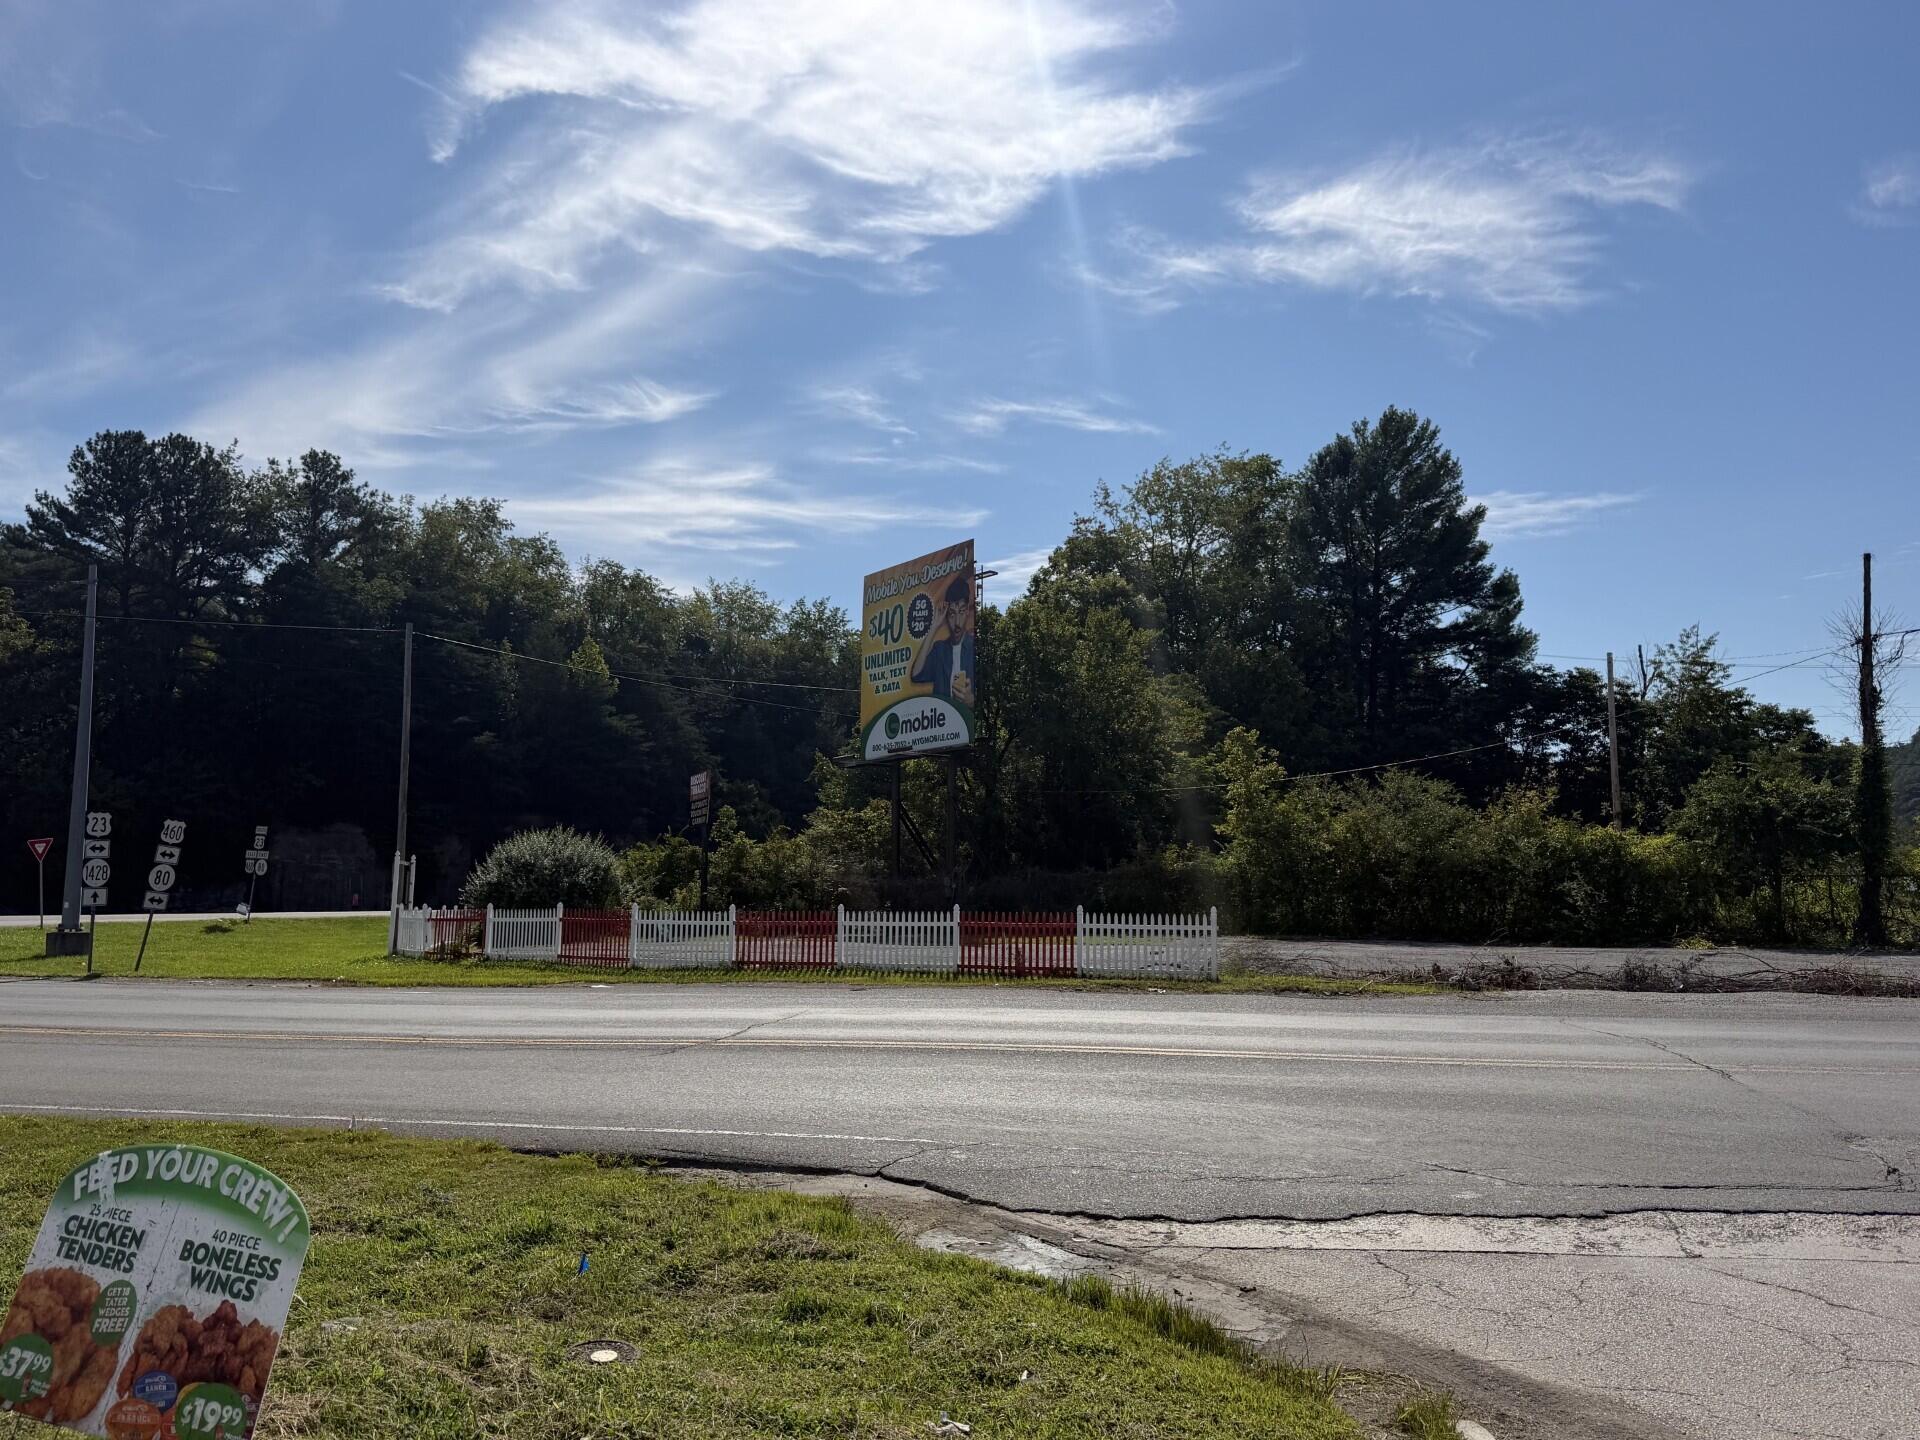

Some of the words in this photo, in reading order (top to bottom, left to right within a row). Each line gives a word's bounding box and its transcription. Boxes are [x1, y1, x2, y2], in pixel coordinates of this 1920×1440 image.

[866, 579, 898, 606] Mobile
[920, 547, 968, 583] Deserve!
[913, 609, 928, 617] PLANS
[915, 600, 927, 610] 5G
[869, 603, 904, 646] $40
[864, 646, 912, 670] UNLIMITED
[869, 670, 888, 682] TALK,
[890, 666, 907, 678] TEXT
[875, 685, 880, 694] &
[882, 682, 900, 692] DATA
[900, 708, 946, 734] mobile
[912, 732, 960, 746] MYGMOBILE.COM
[91, 816, 107, 833] 23
[162, 826, 183, 841] 460
[85, 865, 108, 881] 1428
[154, 870, 170, 885] 80
[146, 1150, 219, 1188] YOUR
[219, 1164, 300, 1244] CREW!
[89, 1203, 102, 1217] 25
[64, 1214, 146, 1251] CHICKEN
[212, 1229, 227, 1244] 40
[228, 1232, 262, 1250] PIECE
[55, 1236, 137, 1274] TENDERS
[178, 1239, 282, 1281] BONELESS
[189, 1266, 259, 1300] WINGS
[107, 1288, 122, 1297] GET
[105, 1298, 128, 1306] TATER
[98, 1307, 130, 1316] WEDGES
[92, 1318, 129, 1332] FREE!
